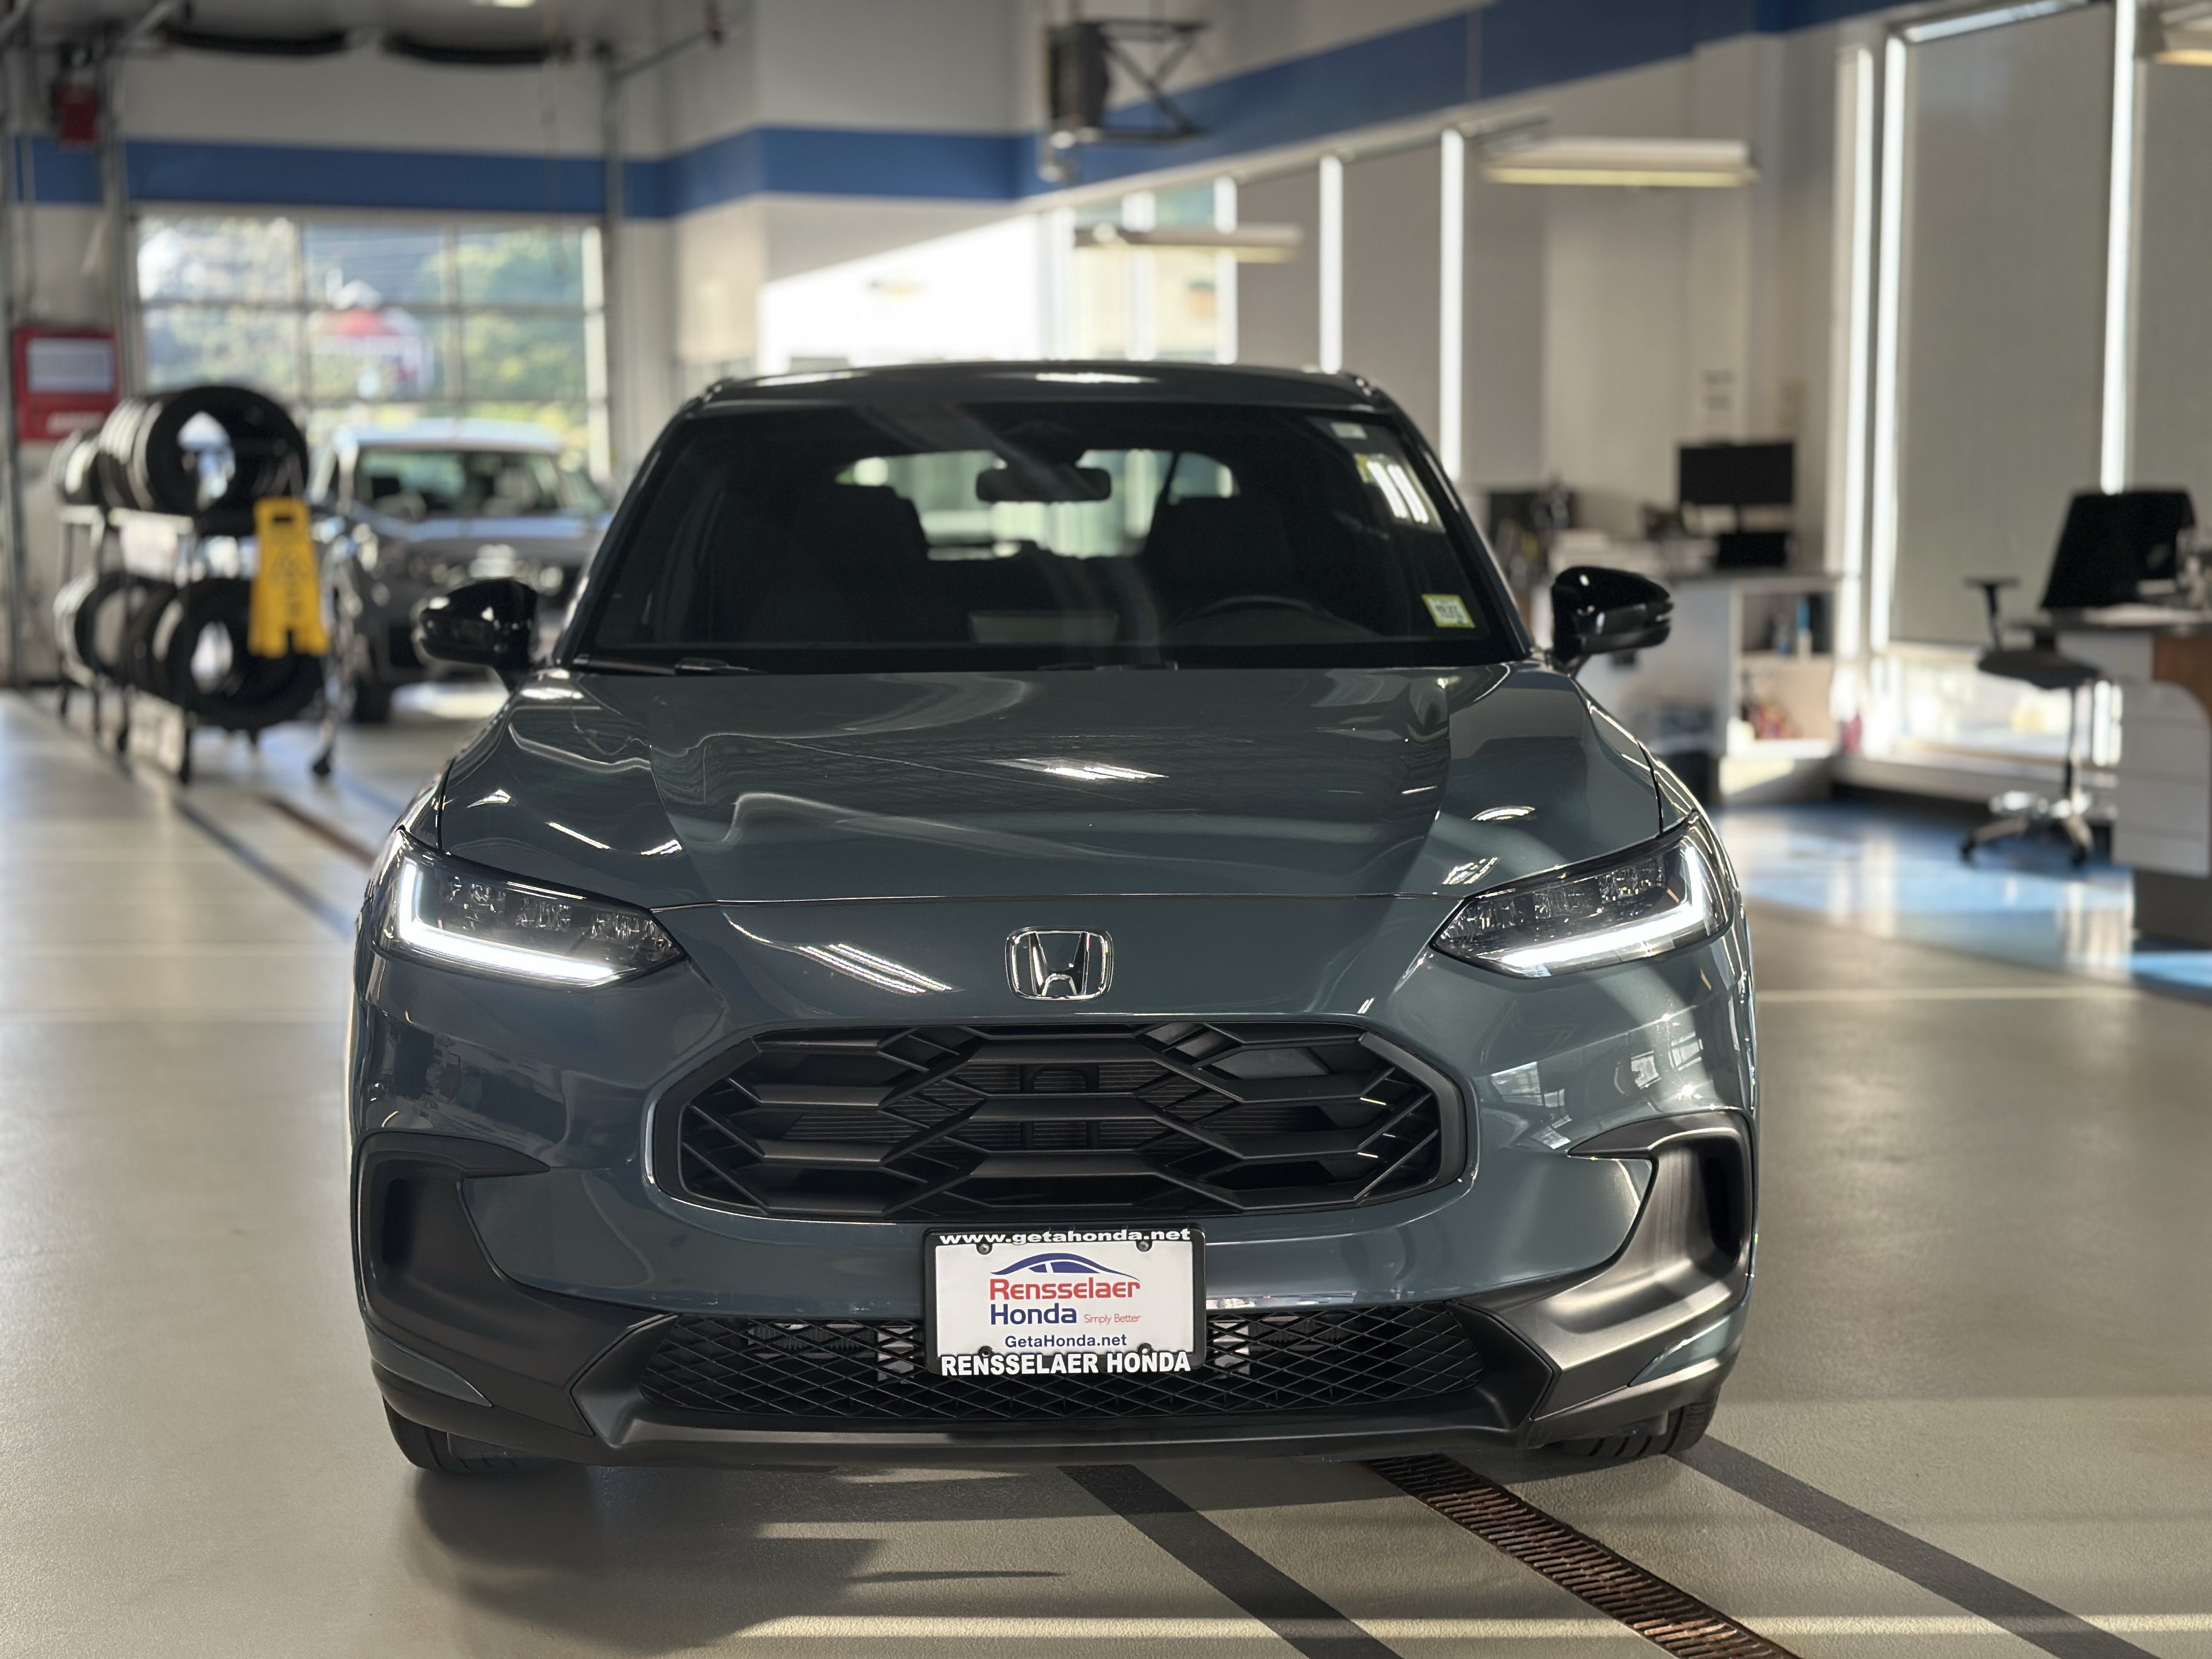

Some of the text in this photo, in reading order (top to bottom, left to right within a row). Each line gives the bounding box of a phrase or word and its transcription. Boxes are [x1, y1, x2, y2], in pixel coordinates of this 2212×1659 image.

[940, 1228, 1190, 1245] www.getahonda.net
[990, 1277, 1140, 1300] Rensselaer
[991, 1302, 1077, 1325] Honda
[1084, 1313, 1141, 1324] Simply Better
[1005, 1334, 1127, 1348] GetaHonda.net
[941, 1351, 1191, 1376] RENSSELAER HONDA
